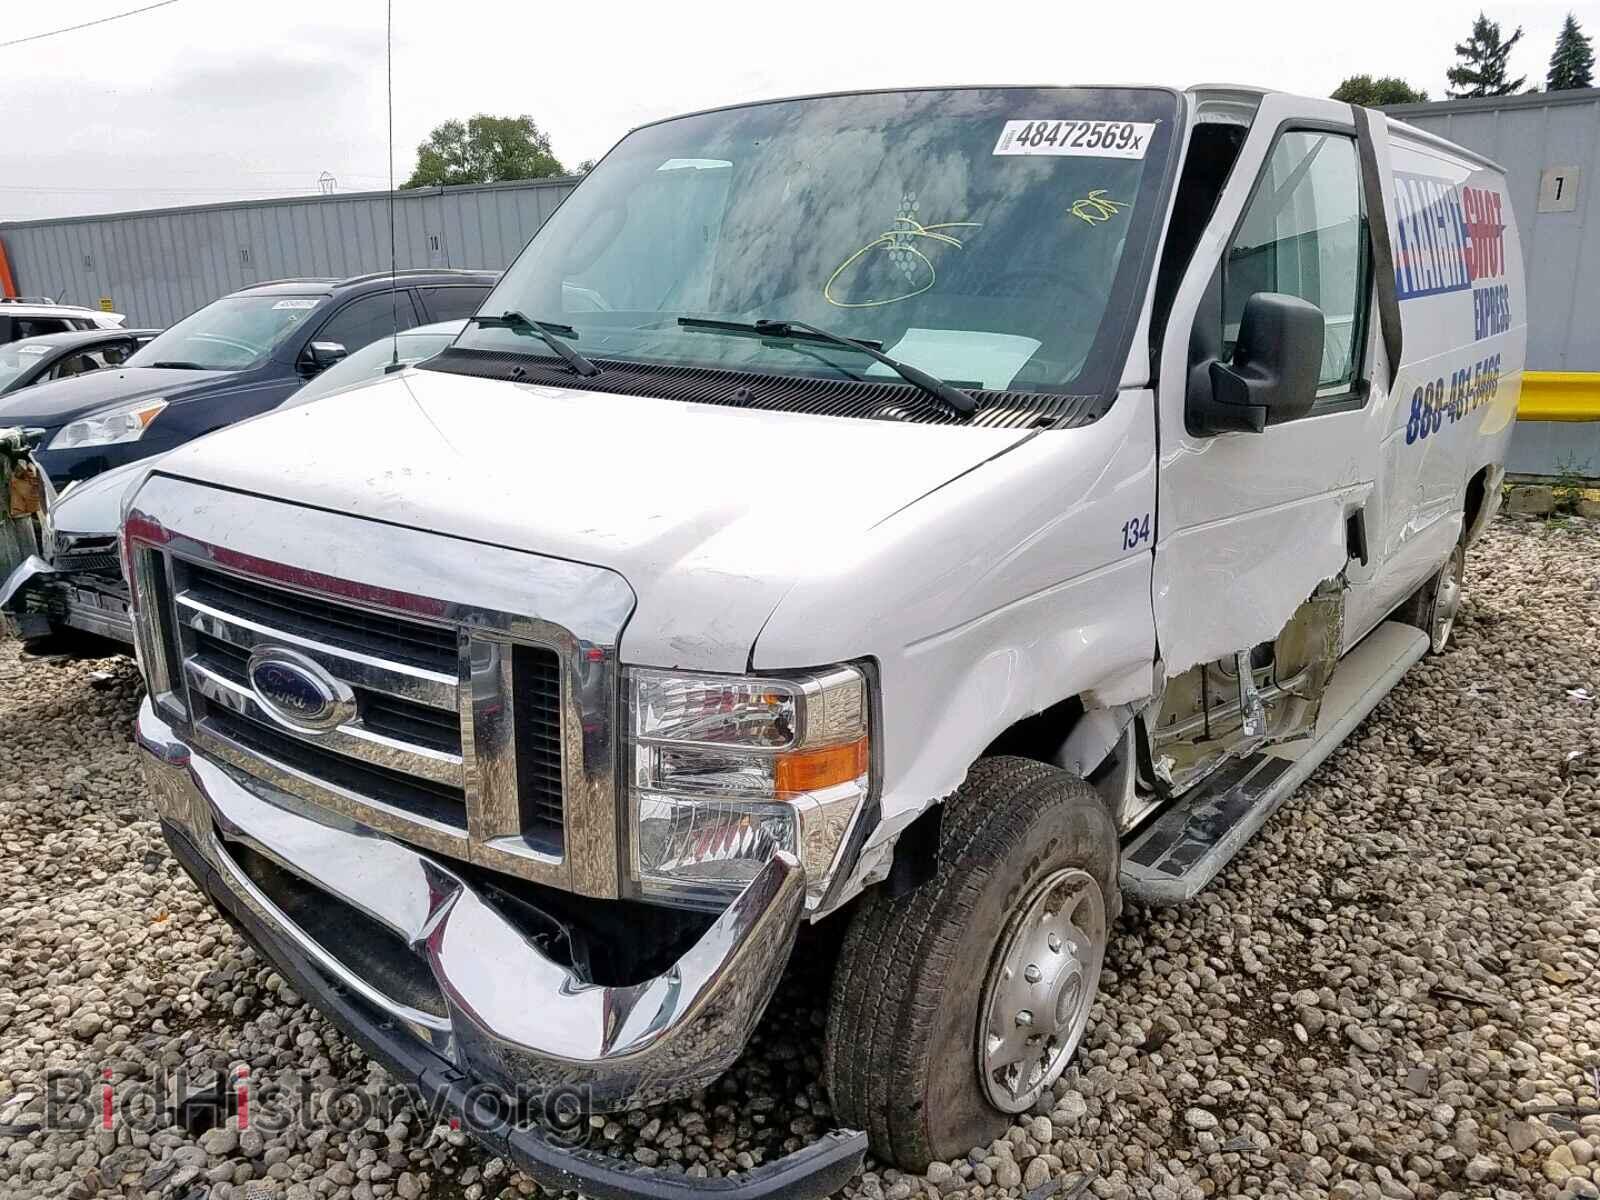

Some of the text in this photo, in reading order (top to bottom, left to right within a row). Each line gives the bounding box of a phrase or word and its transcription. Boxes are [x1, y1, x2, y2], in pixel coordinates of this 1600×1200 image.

[1555, 177, 1564, 201] 7
[1473, 284, 1511, 341] EXPRESS
[1121, 512, 1150, 551] 134
